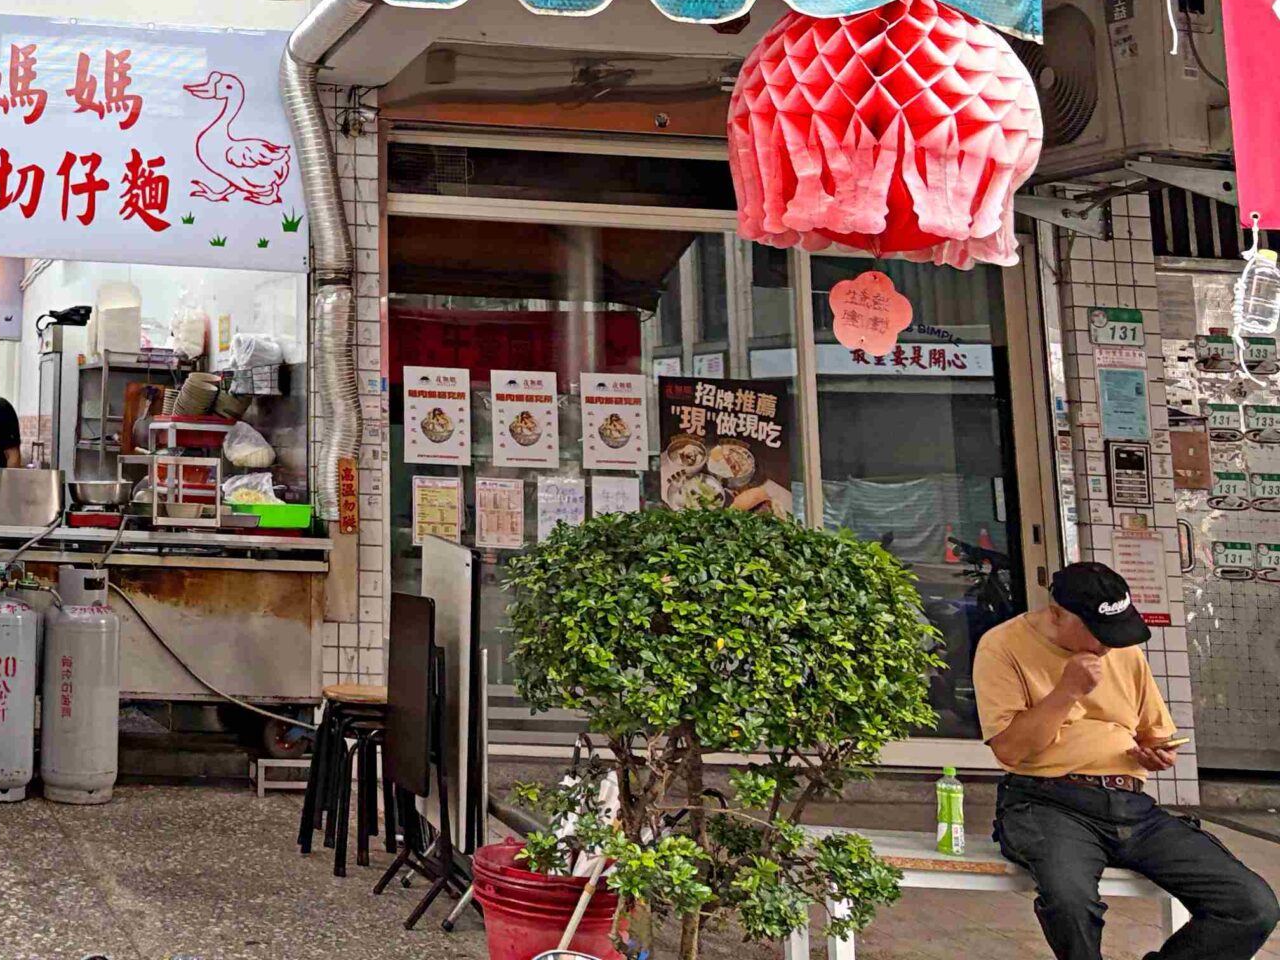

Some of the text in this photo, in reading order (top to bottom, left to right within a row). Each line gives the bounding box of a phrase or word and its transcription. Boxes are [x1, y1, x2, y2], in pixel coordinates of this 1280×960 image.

[1109, 325, 1137, 341] 131
[695, 382, 777, 418] 招牌推薦
